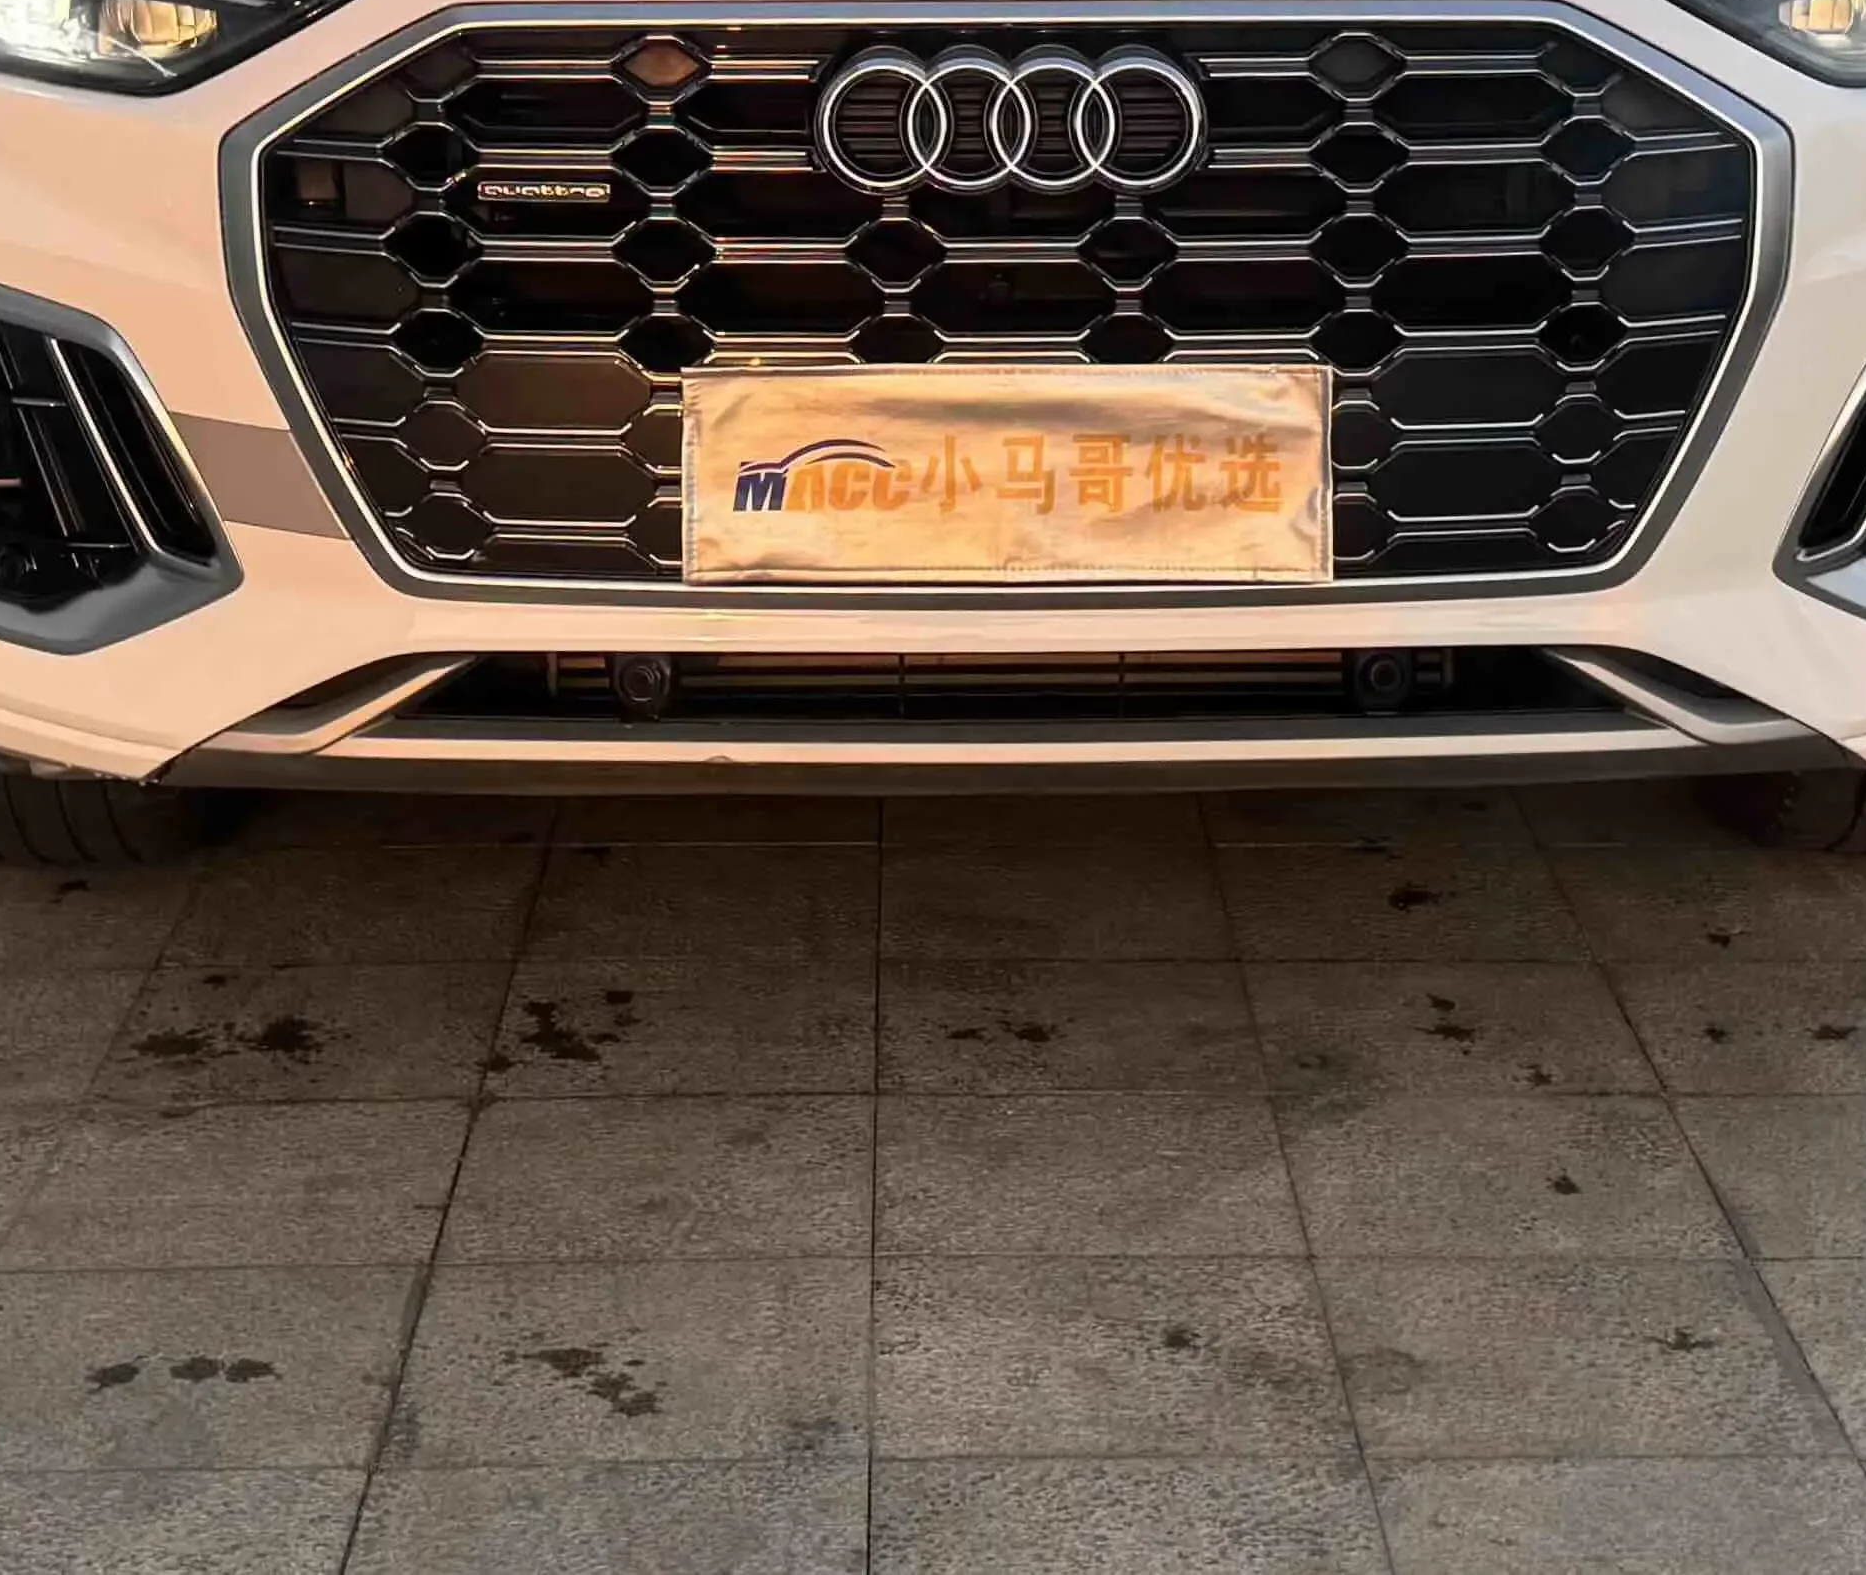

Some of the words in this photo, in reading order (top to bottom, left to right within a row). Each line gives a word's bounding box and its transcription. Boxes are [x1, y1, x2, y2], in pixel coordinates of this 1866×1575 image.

[921, 433, 1282, 515] 小马哥优选
